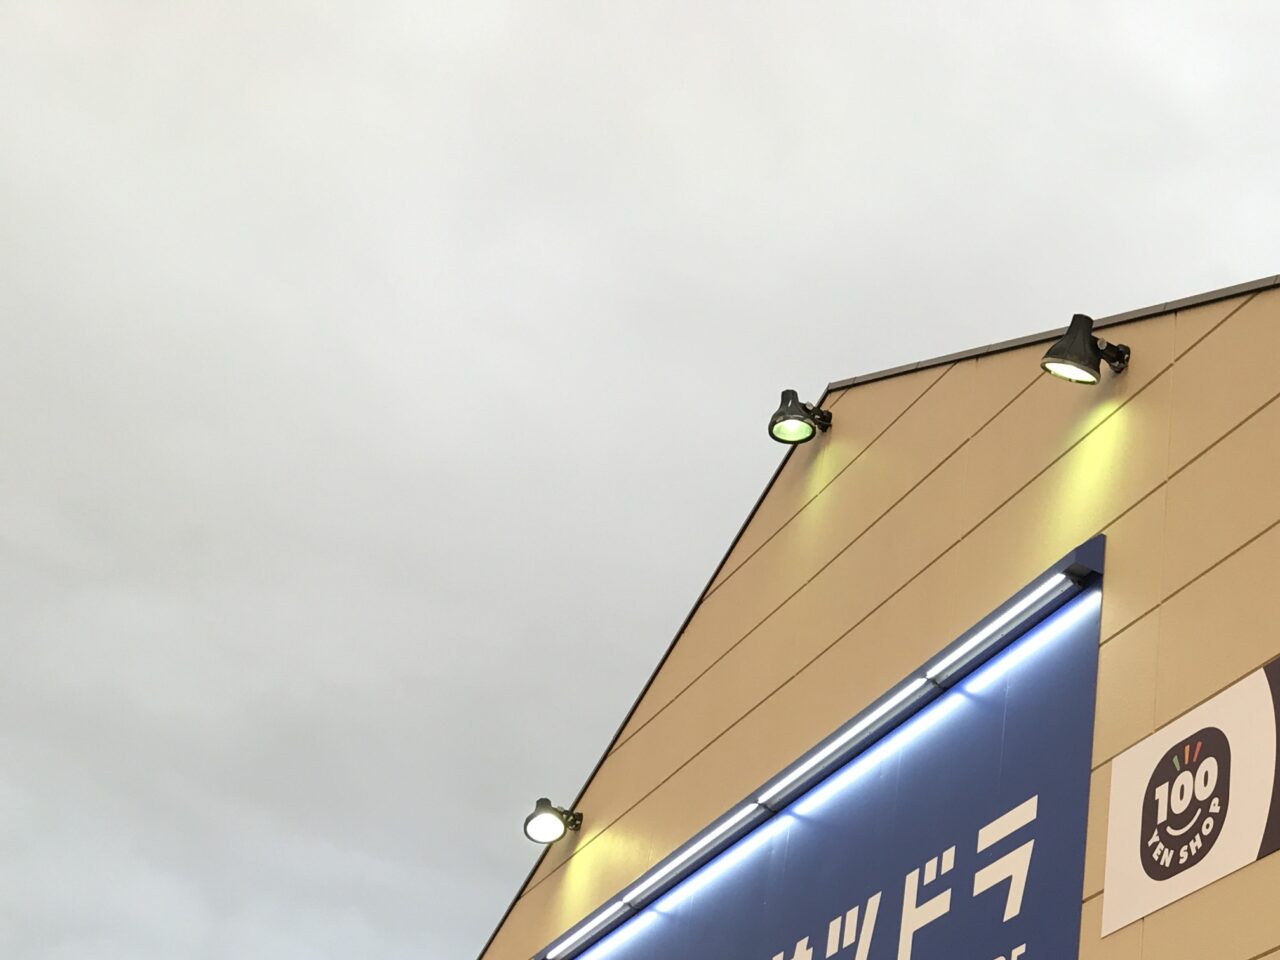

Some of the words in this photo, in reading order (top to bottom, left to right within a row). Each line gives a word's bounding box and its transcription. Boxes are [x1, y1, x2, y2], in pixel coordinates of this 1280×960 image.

[1154, 756, 1219, 825] 100
[1147, 828, 1175, 868] YEN
[1178, 797, 1221, 865] SHOP
